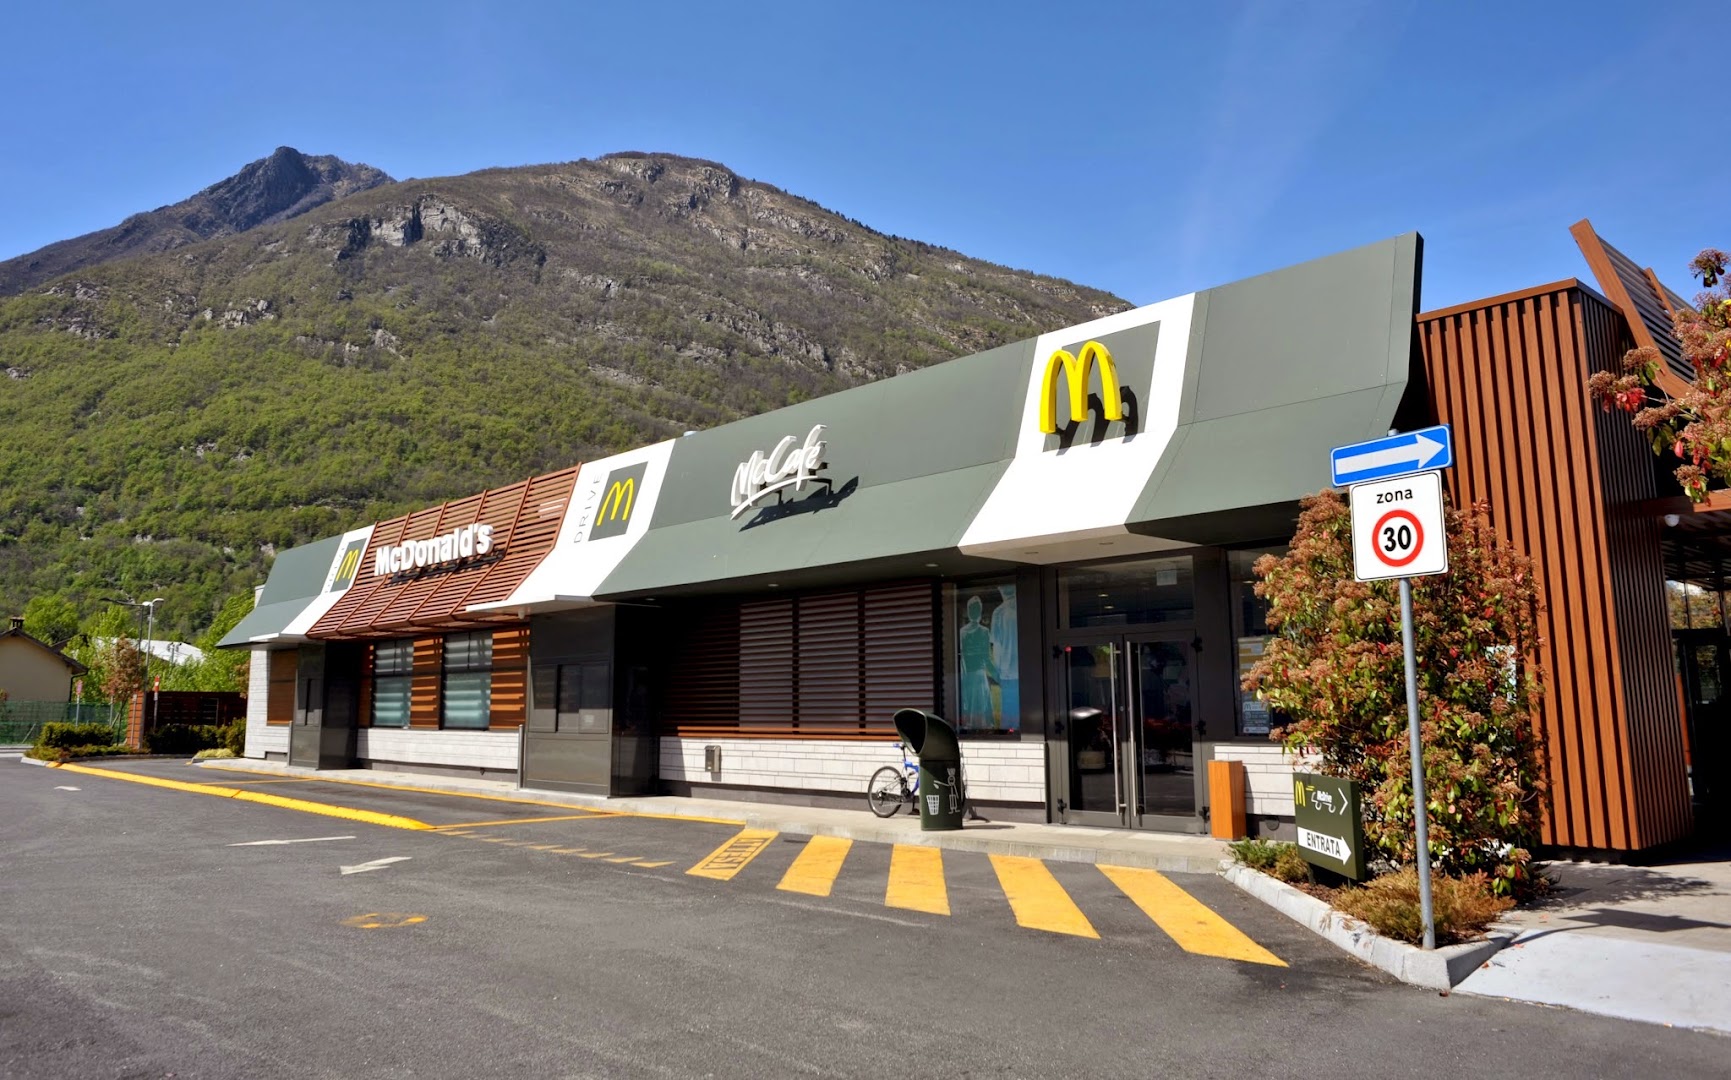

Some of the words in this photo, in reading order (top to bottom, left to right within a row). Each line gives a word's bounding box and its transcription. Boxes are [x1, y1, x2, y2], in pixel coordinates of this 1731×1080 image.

[574, 473, 604, 543] DRIVE
[1376, 488, 1413, 504] zona
[374, 523, 494, 577] McDonald's
[1383, 524, 1411, 552] 30
[1306, 831, 1342, 857] ENTRATA
